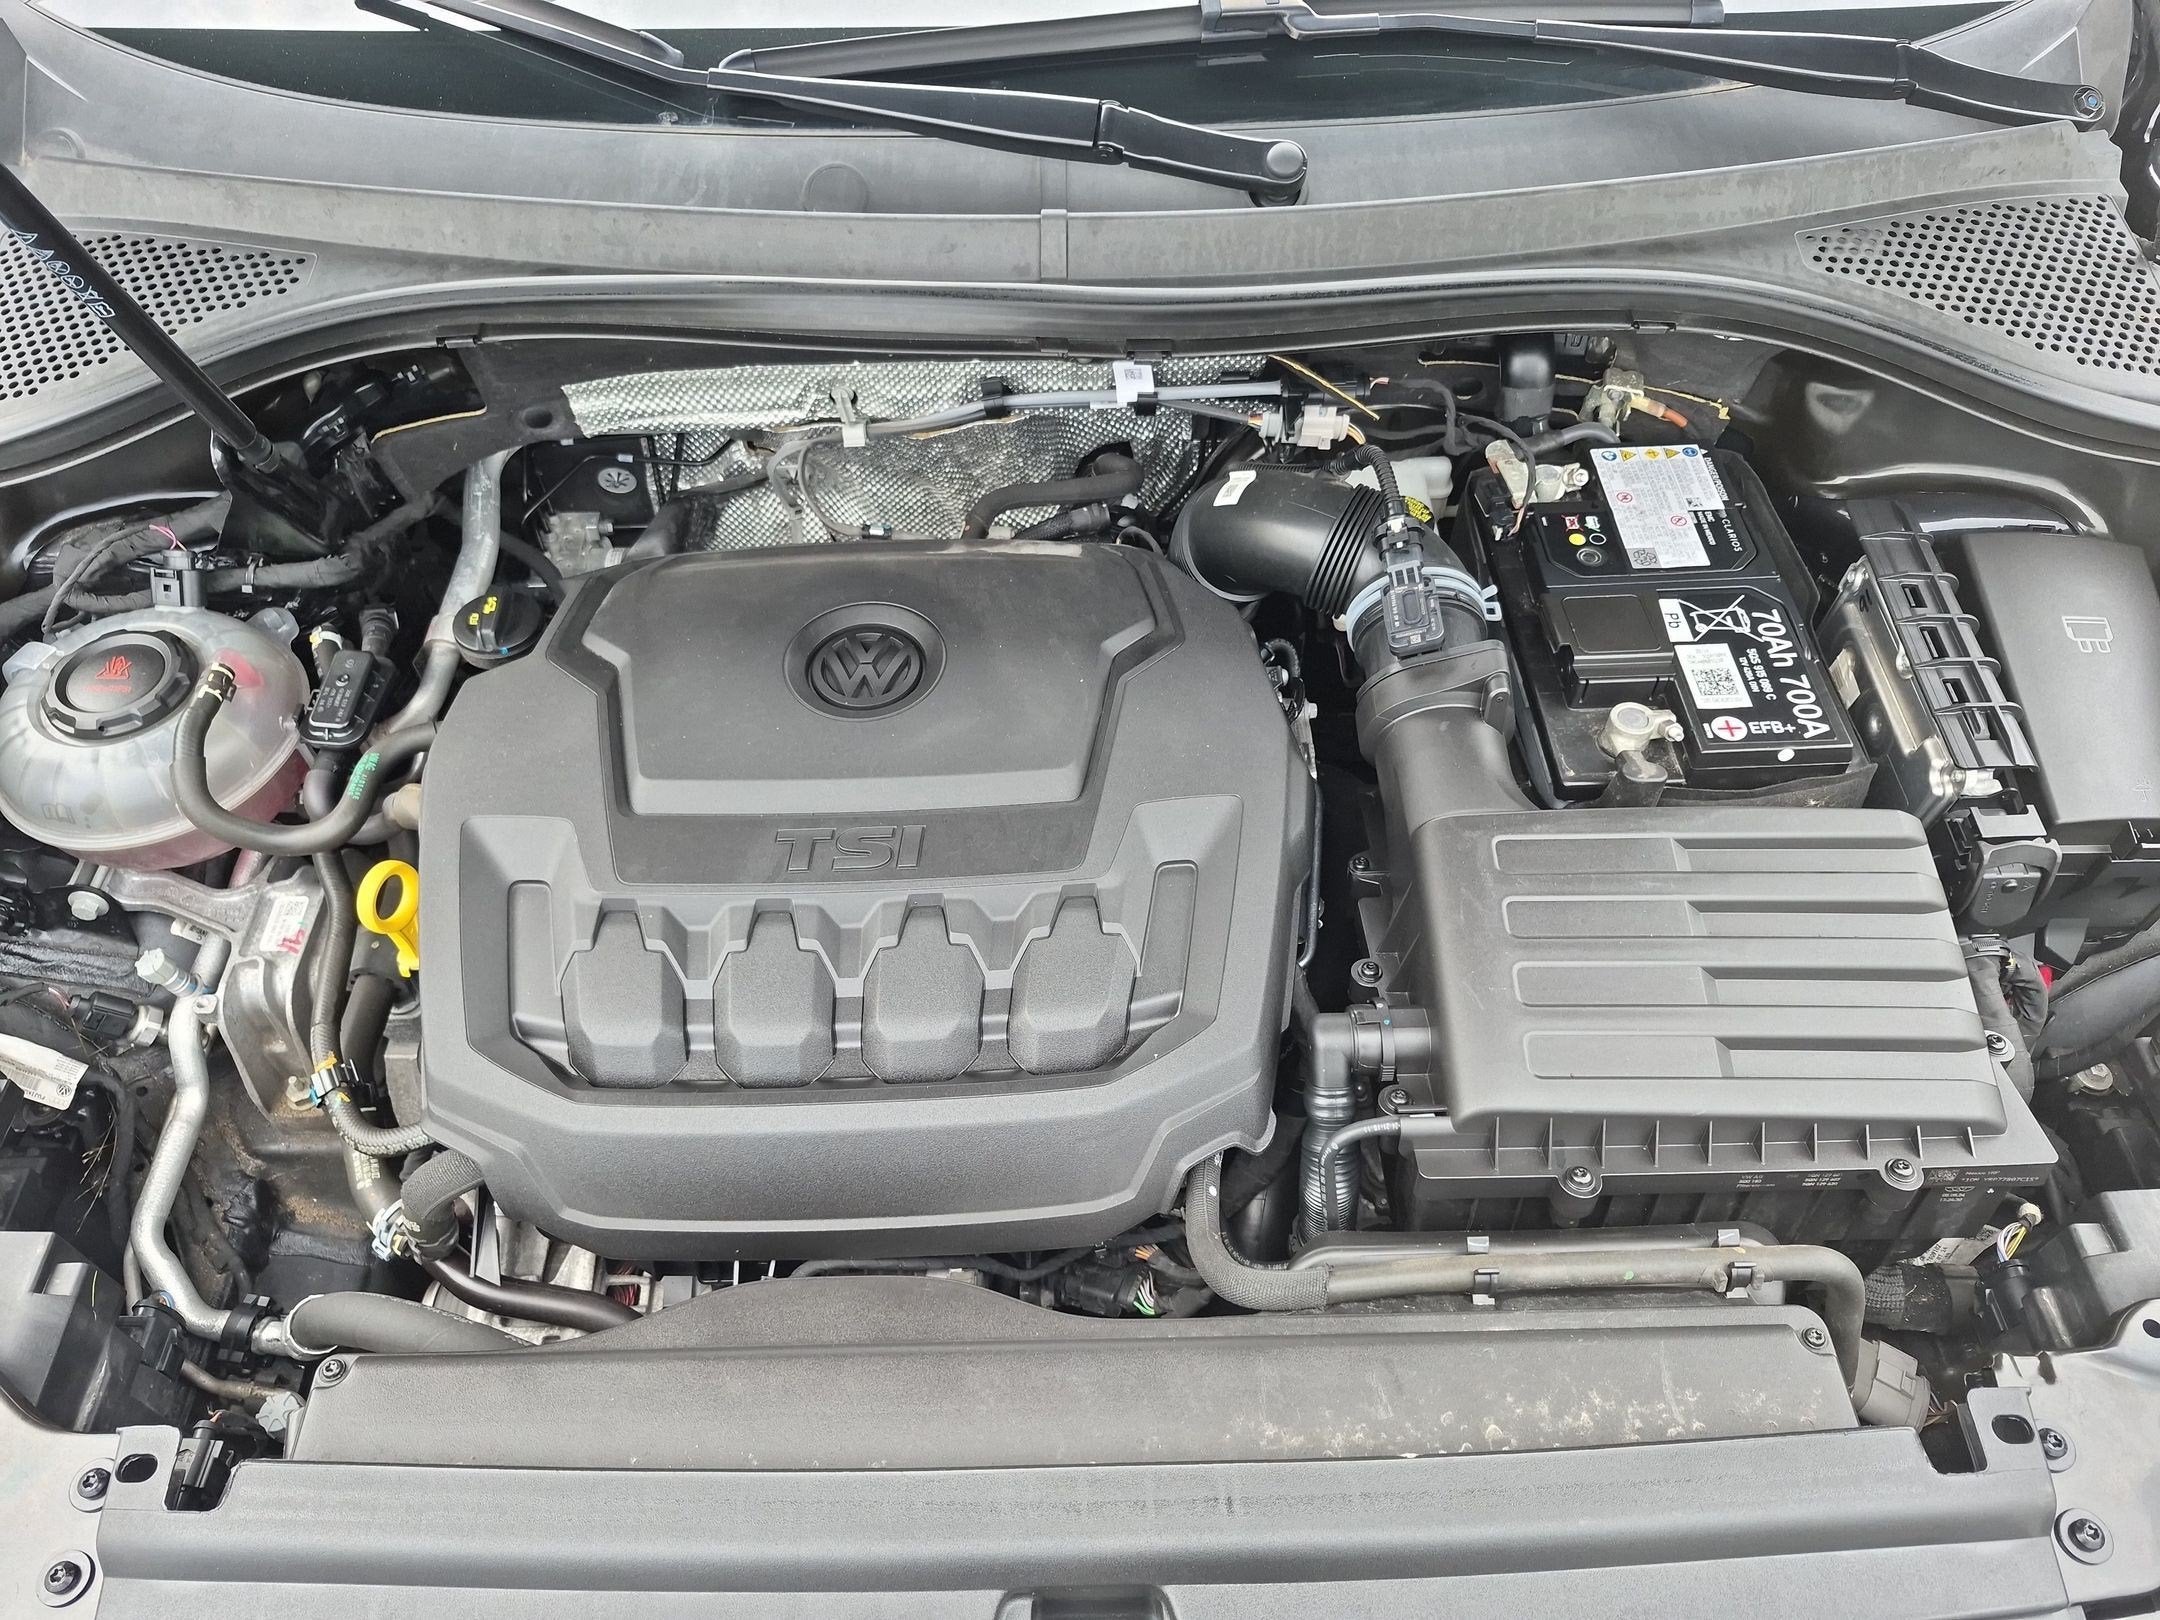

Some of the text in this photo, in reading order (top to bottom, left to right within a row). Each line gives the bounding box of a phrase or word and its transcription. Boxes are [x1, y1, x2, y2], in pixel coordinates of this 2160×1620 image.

[1704, 457, 1730, 501] DANGER/POISON
[1721, 518, 1743, 552] CLARIOS
[1664, 612, 1682, 629] Pb
[1752, 608, 1831, 739] 70Ah 700A
[1748, 721, 1796, 735] EFB+
[775, 825, 927, 873] TSI
